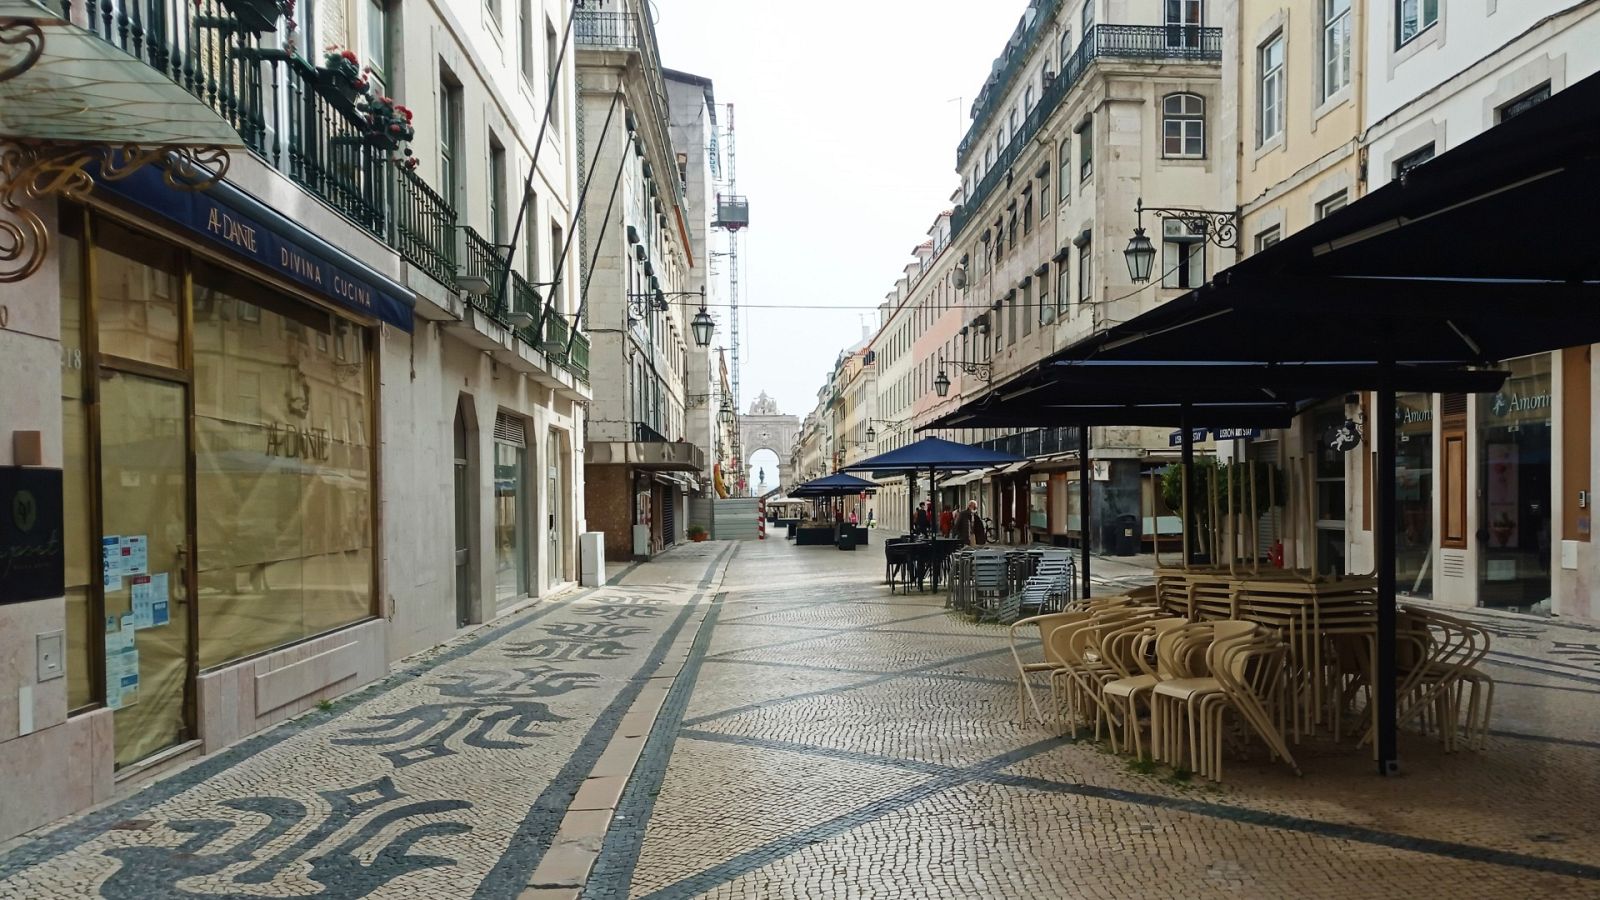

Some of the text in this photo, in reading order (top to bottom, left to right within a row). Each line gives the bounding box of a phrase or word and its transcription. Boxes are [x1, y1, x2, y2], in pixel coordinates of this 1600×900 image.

[223, 213, 257, 253] DANTE
[281, 247, 322, 284] DIVINA
[333, 276, 371, 307] CUCINA
[285, 424, 329, 462] DANTE
